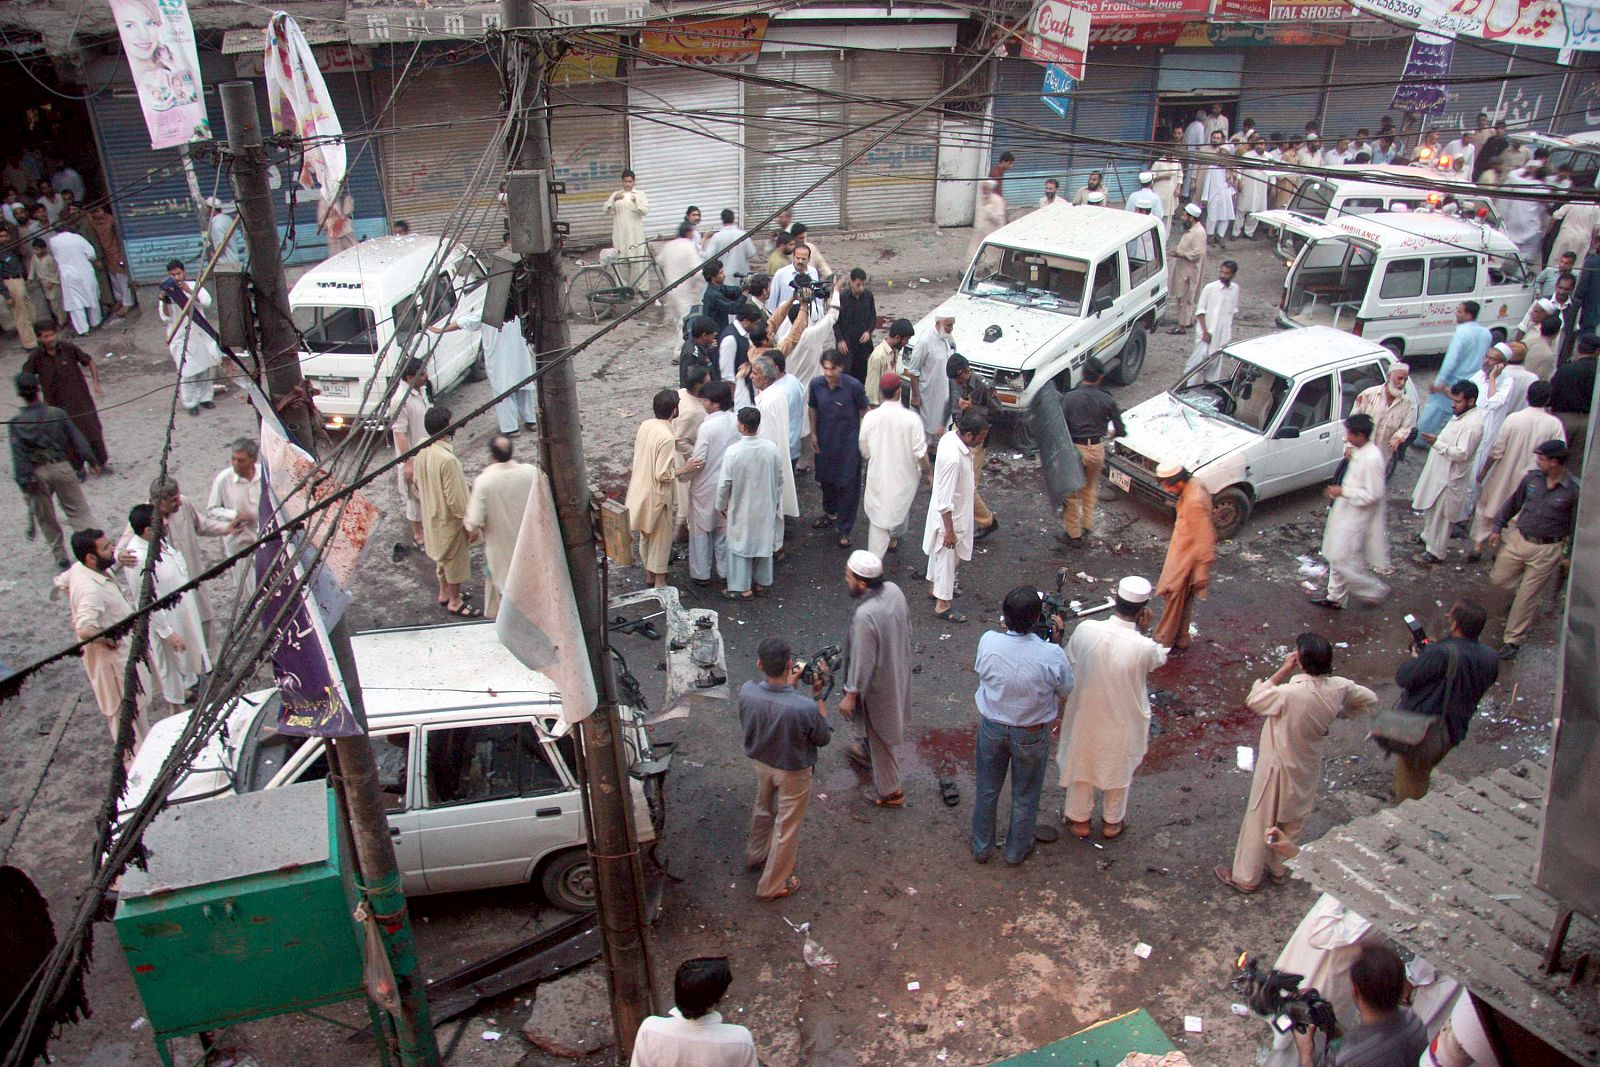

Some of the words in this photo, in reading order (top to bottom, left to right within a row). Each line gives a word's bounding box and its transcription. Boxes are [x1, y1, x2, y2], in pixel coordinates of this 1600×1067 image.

[1149, 0, 1183, 9] House
[1300, 6, 1342, 19] SHOES
[1038, 4, 1075, 38] Bata
[1088, 25, 1137, 42] ata
[702, 41, 750, 49] SHOES
[1340, 223, 1381, 241] AMBULANCE
